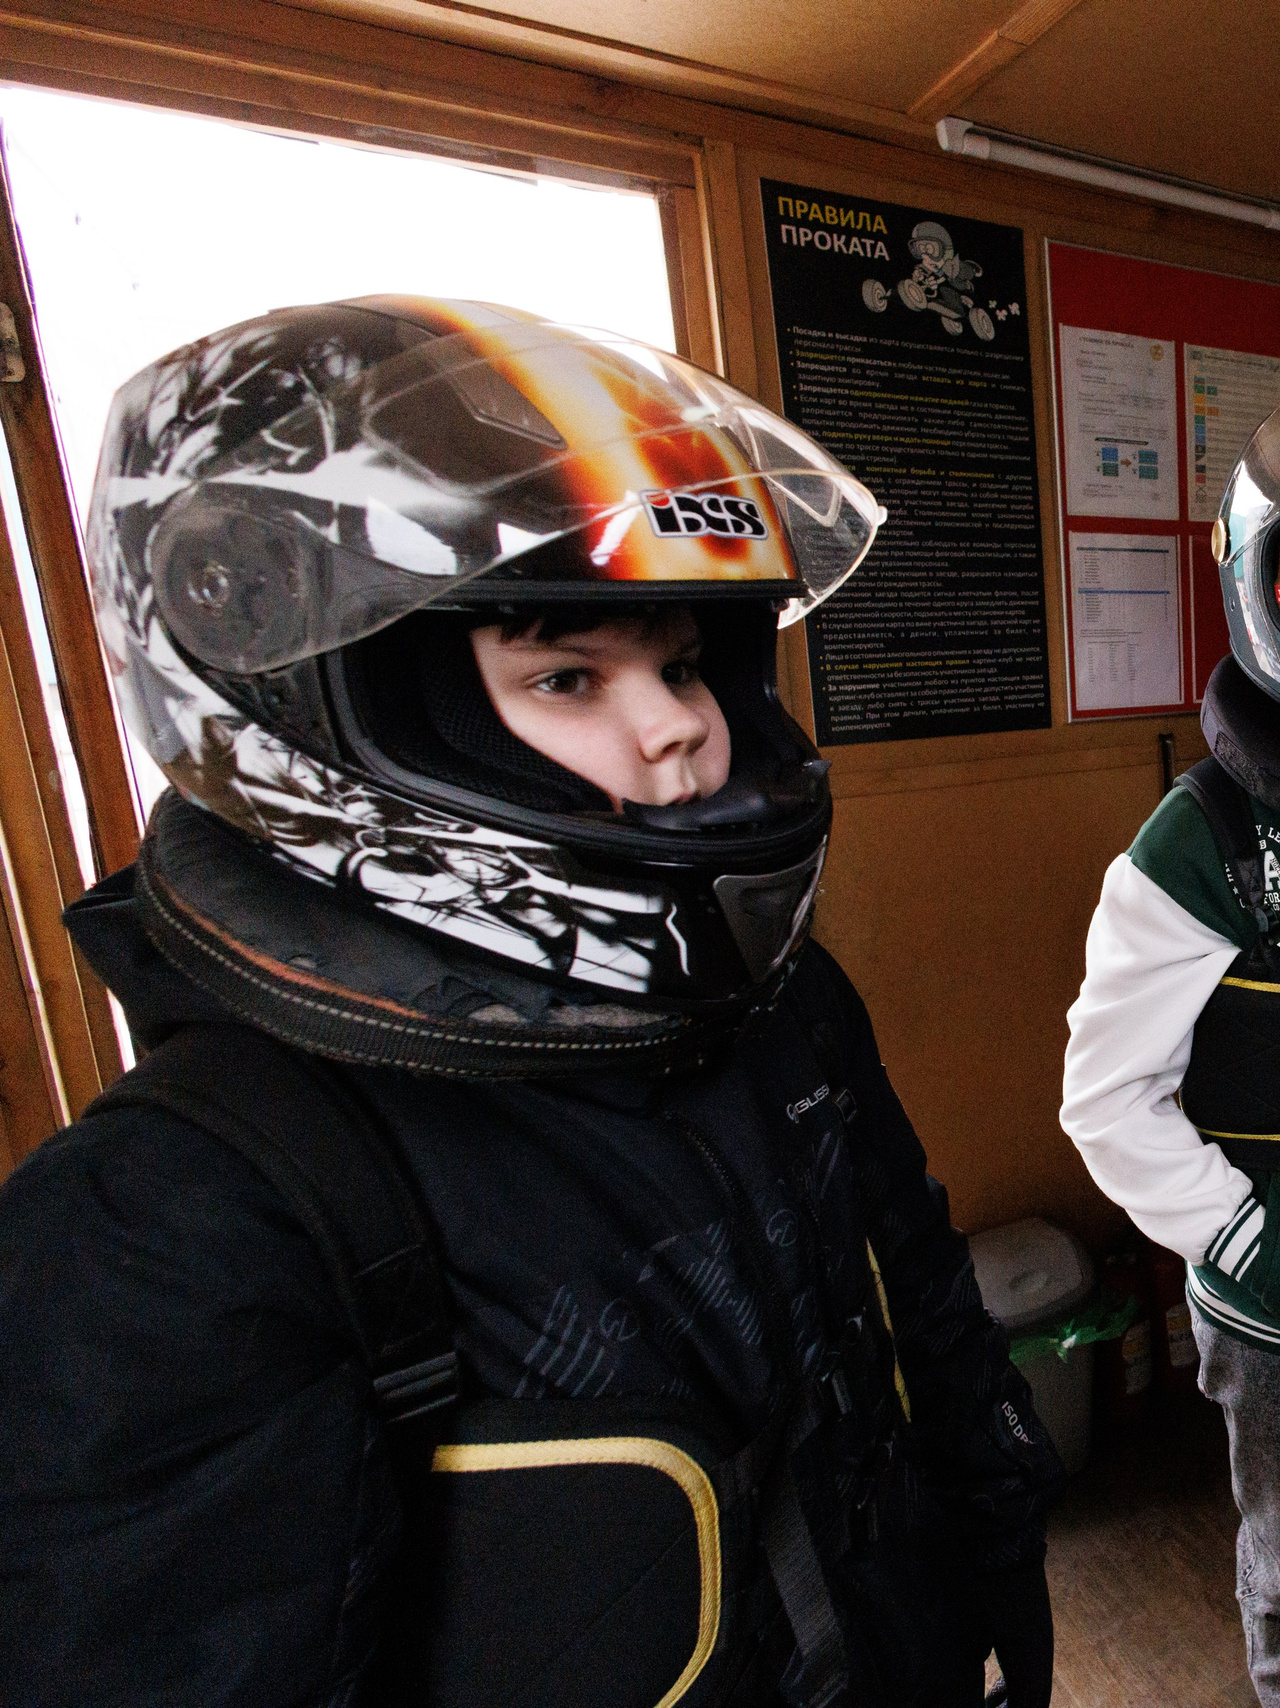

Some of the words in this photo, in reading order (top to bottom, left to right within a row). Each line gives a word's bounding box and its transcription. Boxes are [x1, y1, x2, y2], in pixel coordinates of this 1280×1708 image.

[777, 196, 888, 235] ПРАВИЛА
[780, 223, 890, 261] ПРОКАТА
[1001, 1401, 1018, 1426] ISO
